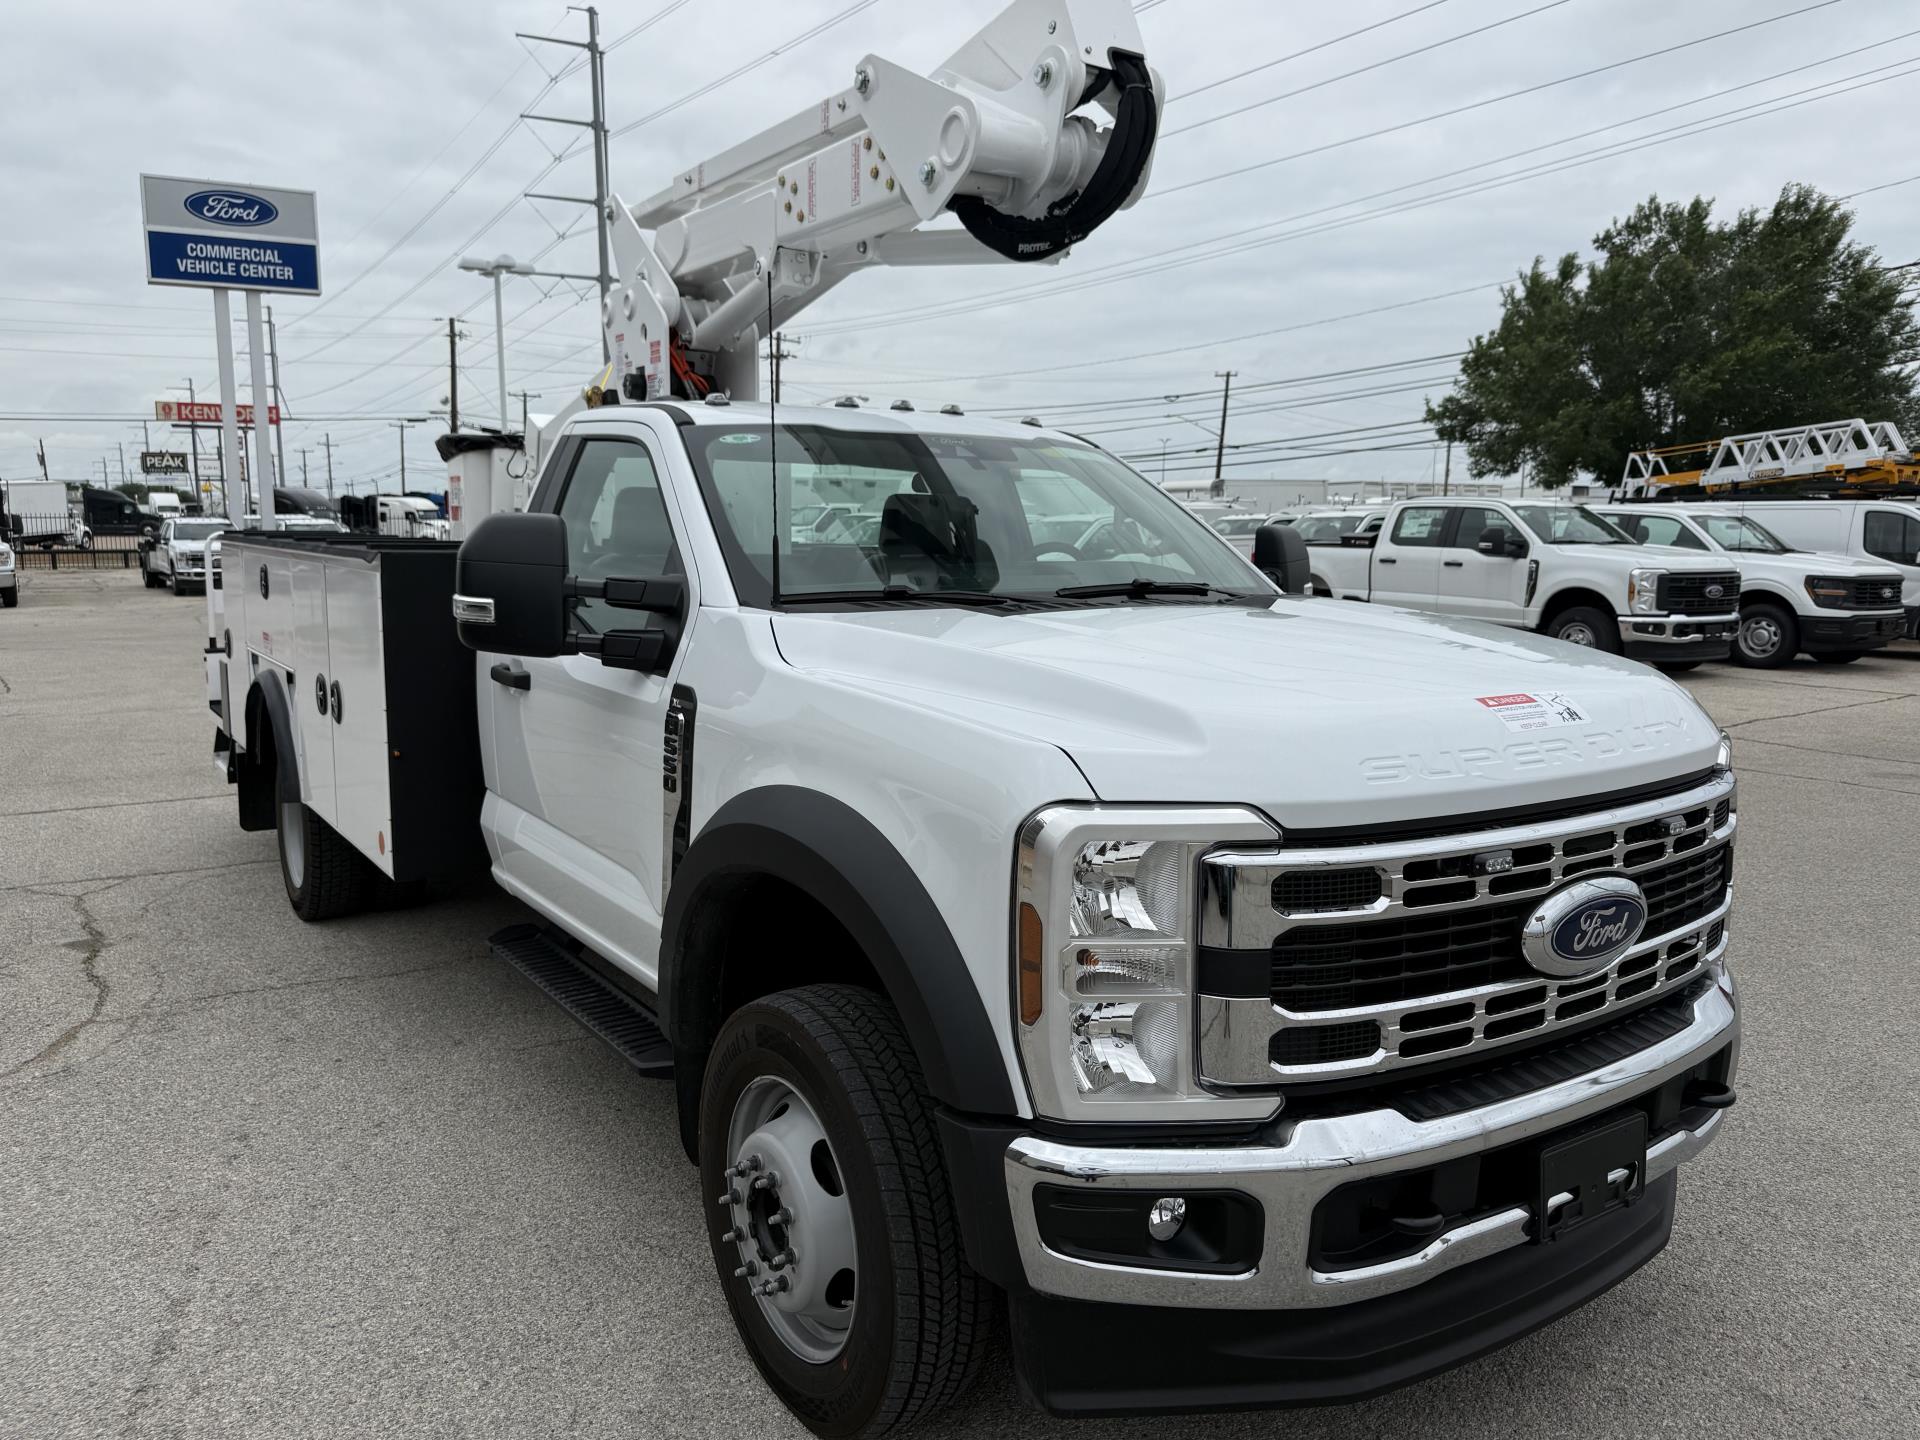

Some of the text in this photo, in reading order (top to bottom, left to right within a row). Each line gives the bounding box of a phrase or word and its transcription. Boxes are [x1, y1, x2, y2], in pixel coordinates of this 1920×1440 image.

[203, 195, 259, 221] Ford
[187, 243, 282, 264] COMMERCIAL
[176, 258, 294, 281] VEHICLE CENTER
[181, 405, 277, 421] KENORH
[146, 452, 184, 468] PEAK
[1359, 718, 1695, 785] SUPER DUTY
[1573, 906, 1630, 952] Ford
